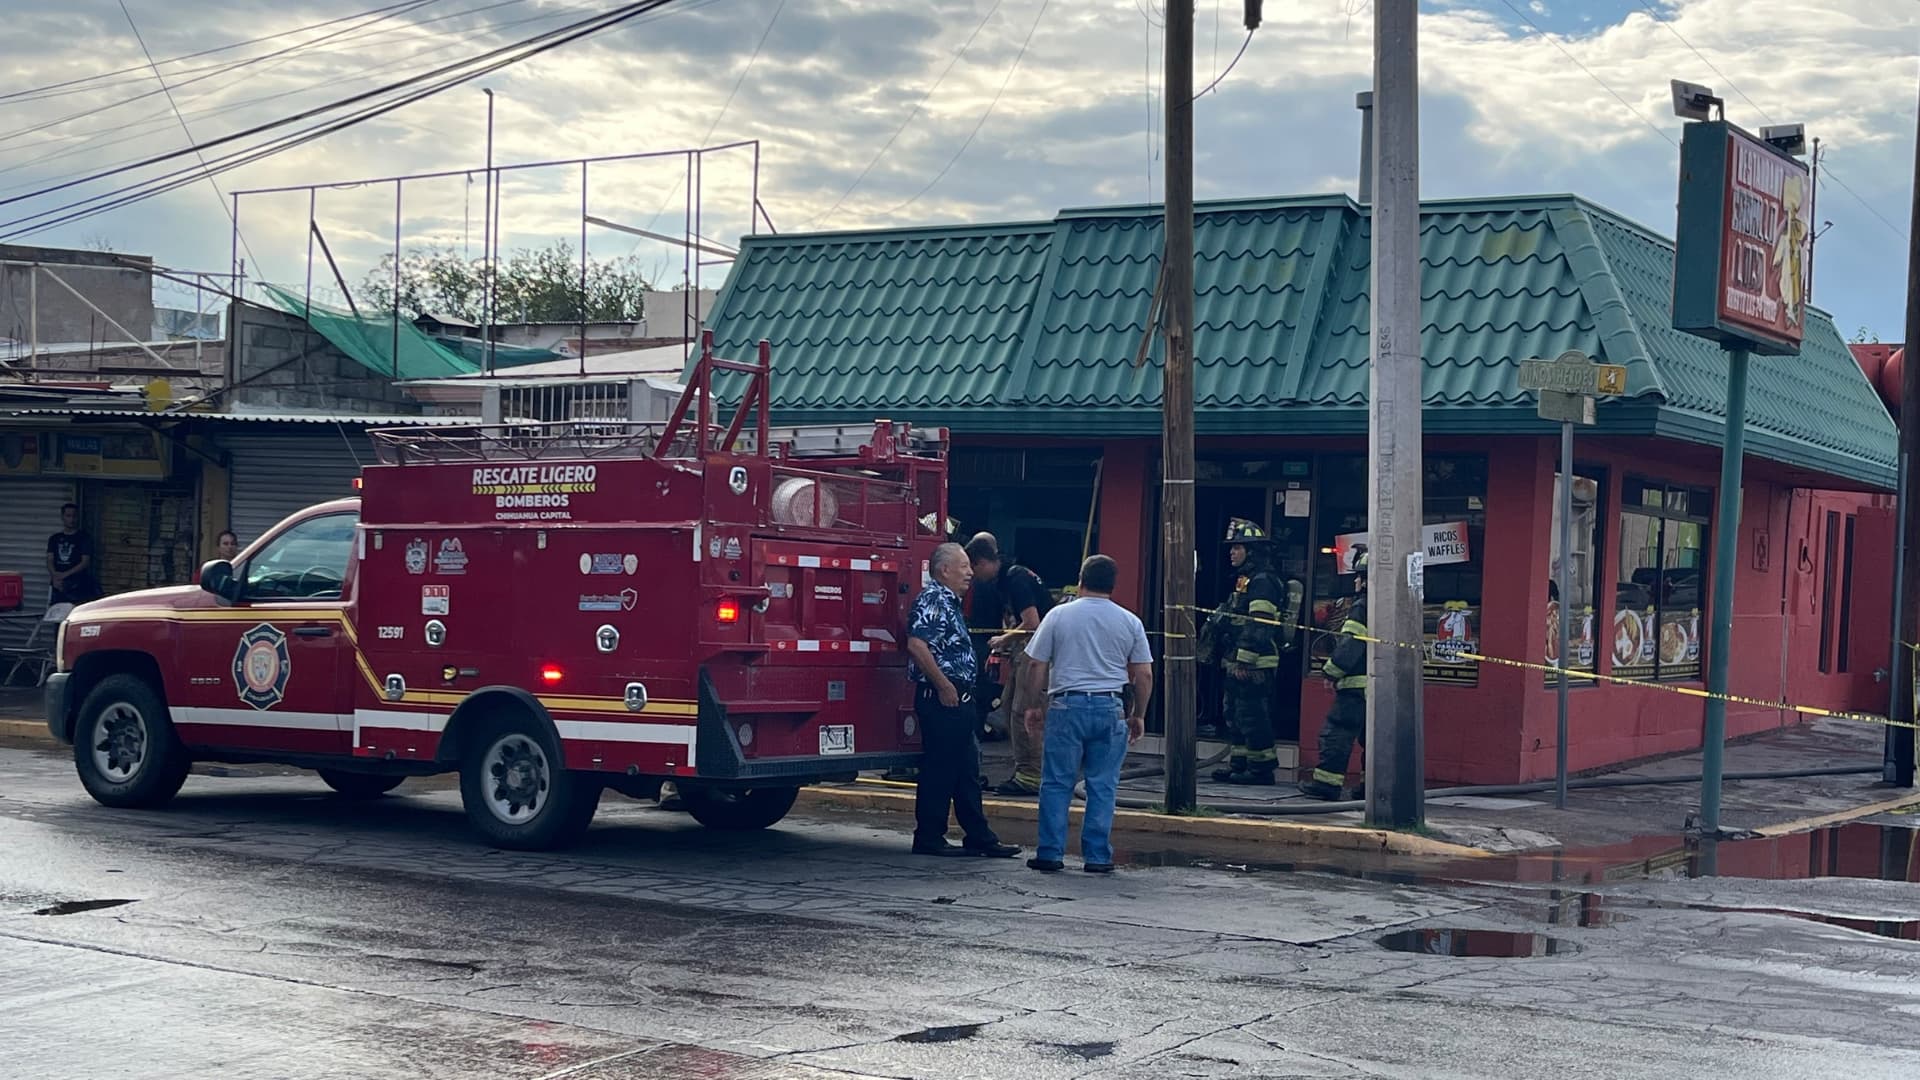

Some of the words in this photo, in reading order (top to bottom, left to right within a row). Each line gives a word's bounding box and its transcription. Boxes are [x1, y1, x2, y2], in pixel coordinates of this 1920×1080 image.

[473, 467, 538, 485] RESCATE
[540, 465, 596, 483] LIGERO
[496, 495, 569, 508] BOMBEROS
[496, 512, 539, 520] CHIHUAHUA
[1433, 530, 1458, 543] RICOS
[1427, 544, 1466, 557] WAFFLES
[424, 587, 447, 597] 911
[378, 626, 404, 639] 12591
